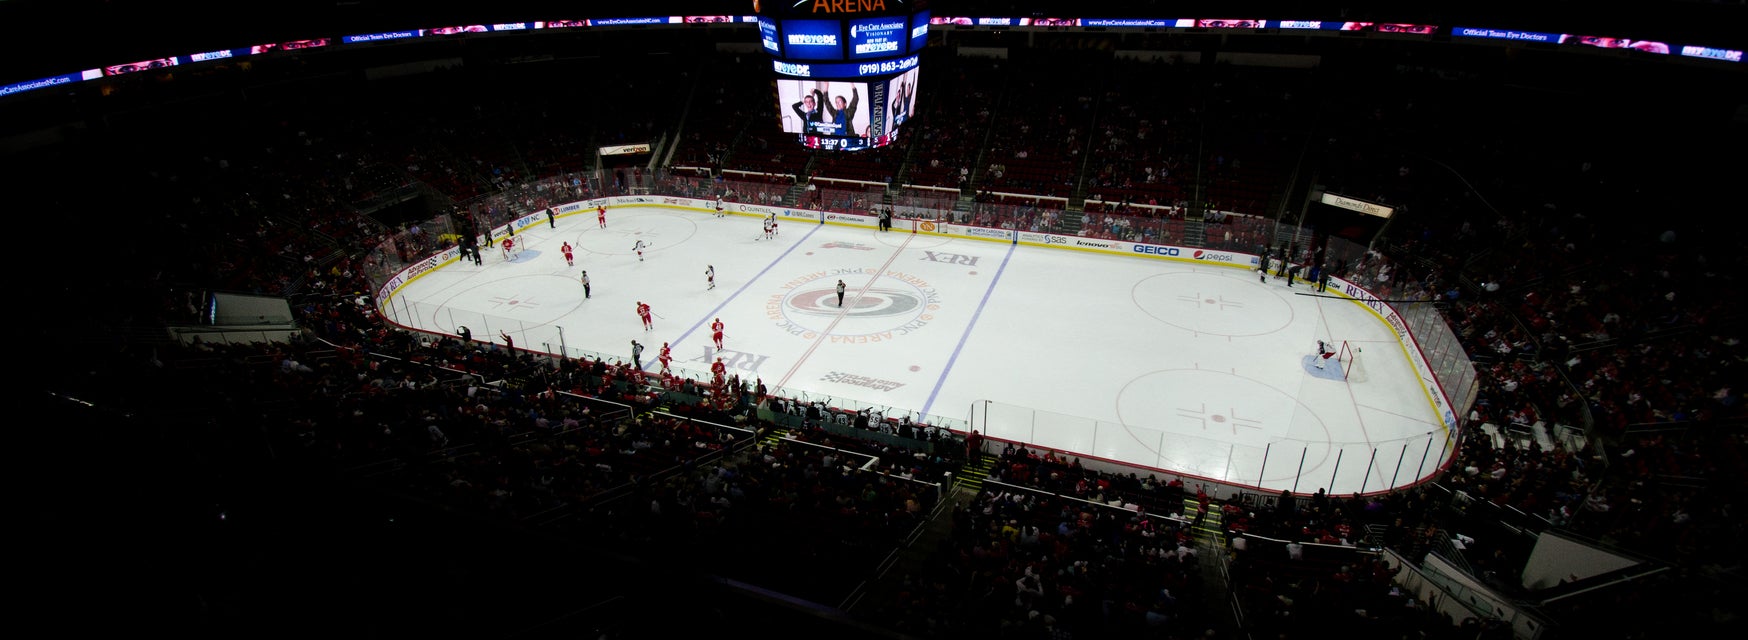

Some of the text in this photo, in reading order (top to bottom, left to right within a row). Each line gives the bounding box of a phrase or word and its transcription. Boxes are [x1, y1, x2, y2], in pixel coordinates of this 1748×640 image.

[812, 0, 886, 13] ARENA
[1463, 28, 1488, 36] Official
[1506, 31, 1520, 39] Eye
[1520, 32, 1547, 41] Doctors
[859, 63, 880, 76] (919)
[874, 107, 882, 136] NEWS
[821, 138, 839, 146] 13:37
[841, 138, 848, 147] 0
[560, 204, 580, 213] LUMBER
[1335, 197, 1380, 214] Diamonds Direct
[1051, 235, 1067, 244] sas
[1076, 240, 1109, 248] lenovo
[1133, 244, 1180, 256] GEICO
[1206, 251, 1233, 262] pepsi
[918, 250, 982, 267] REX
[408, 260, 430, 275] Advance
[389, 276, 403, 292] REX
[780, 268, 863, 290] PNC ARENA
[886, 270, 941, 305] PNC ARENA
[1346, 284, 1385, 315] REX REX
[766, 293, 806, 337] PNC ARENA
[830, 320, 929, 344] PNC ARENA
[690, 345, 770, 371] REX
[839, 376, 896, 392] Advance
[869, 415, 879, 423] 55
